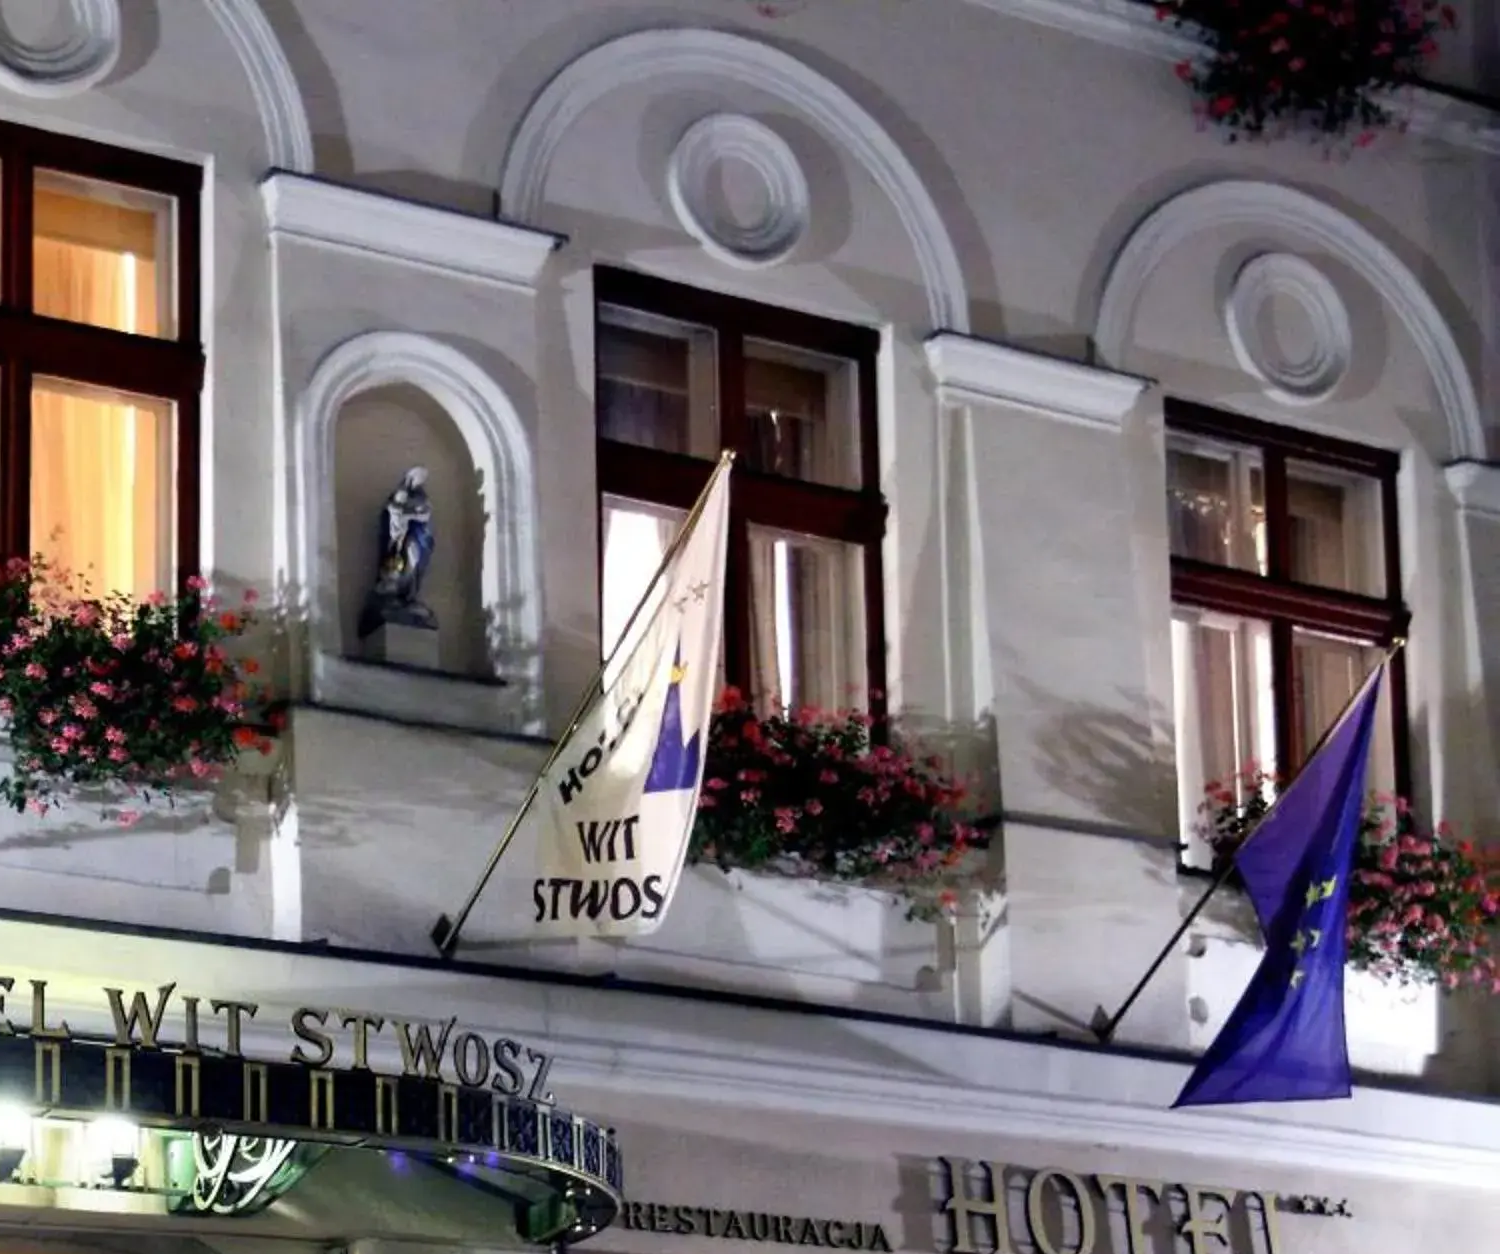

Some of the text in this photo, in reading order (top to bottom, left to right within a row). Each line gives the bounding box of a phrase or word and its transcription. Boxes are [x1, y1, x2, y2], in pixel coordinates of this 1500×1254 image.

[576, 815, 640, 864] WIT
[103, 982, 259, 1057] WIT
[290, 1006, 557, 1107] STWOSZ
[623, 1201, 894, 1253] RESTAURACJA
